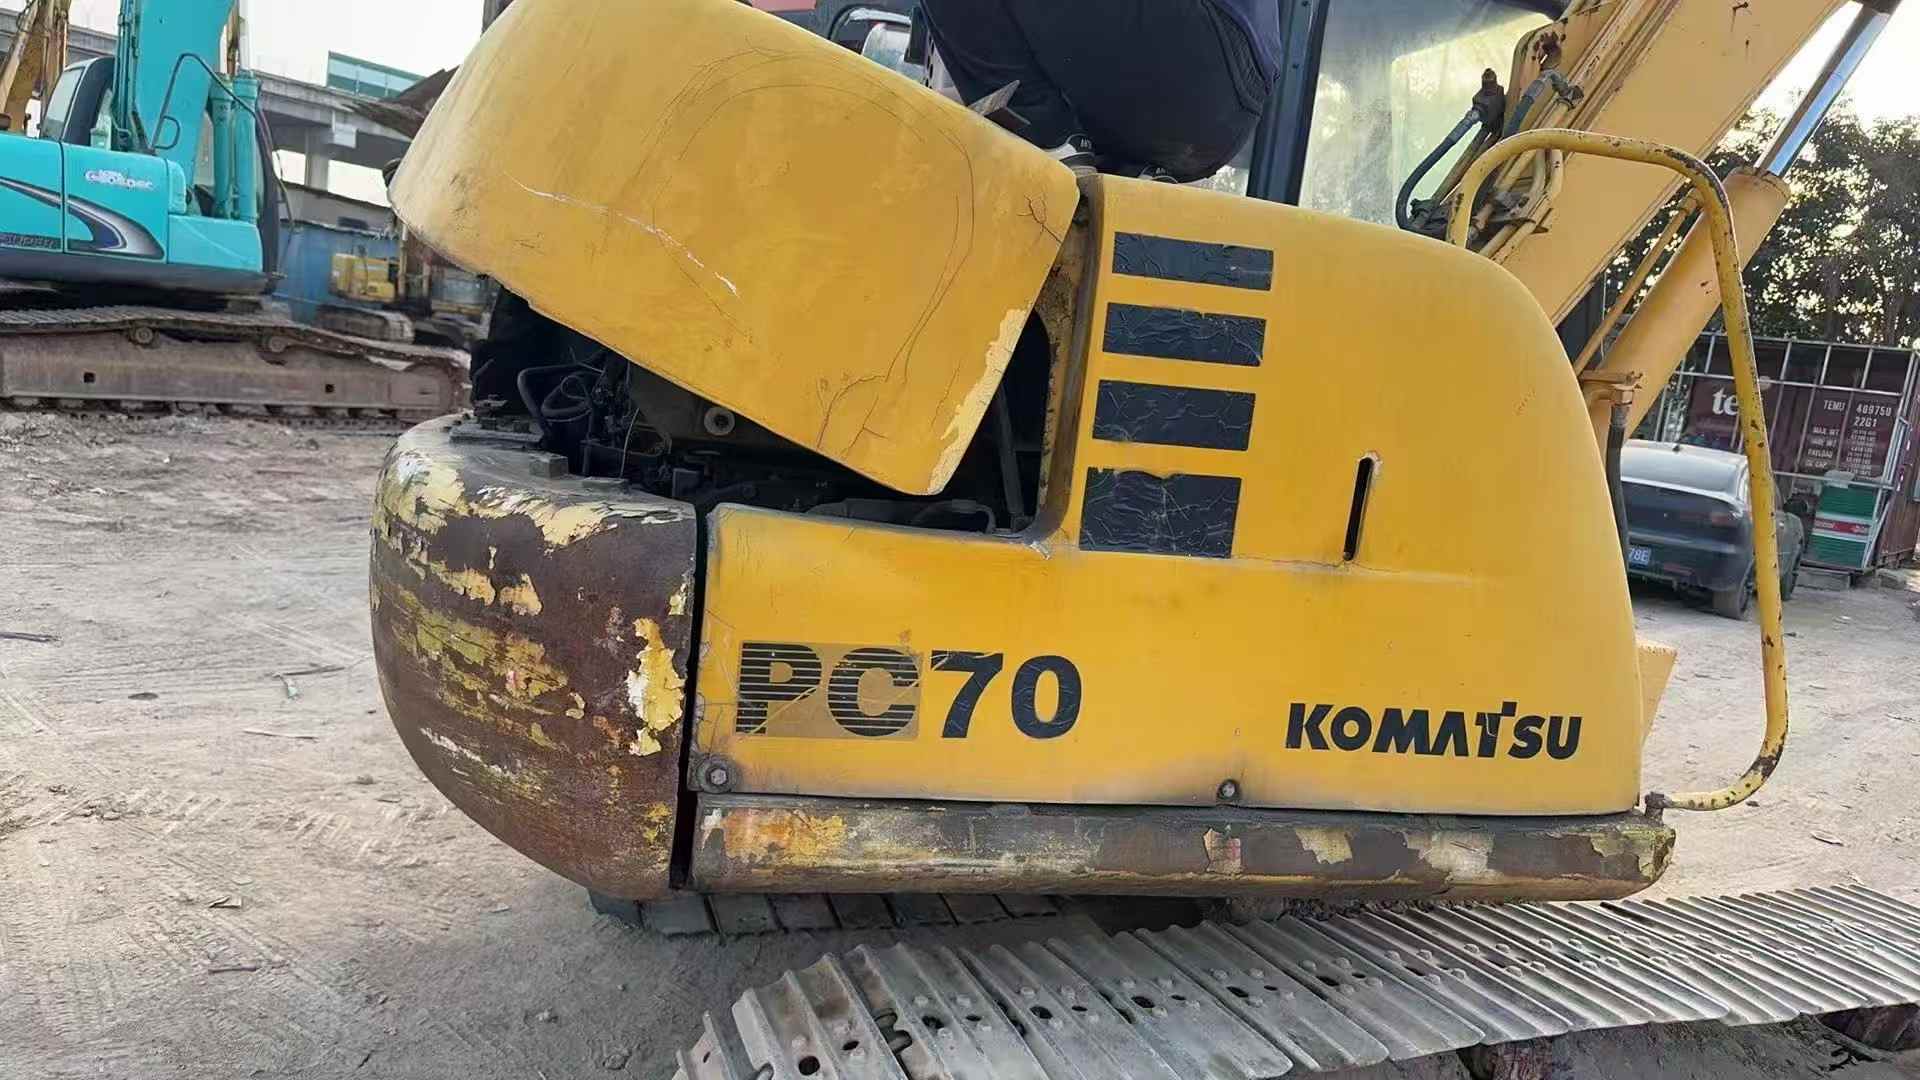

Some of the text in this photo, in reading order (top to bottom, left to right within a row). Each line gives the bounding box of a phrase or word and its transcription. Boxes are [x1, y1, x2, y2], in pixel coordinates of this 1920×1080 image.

[1712, 387, 1739, 416] te
[1823, 399, 1846, 411] TEMU
[1854, 417, 1878, 427] 22G1
[735, 642, 1083, 739] PC70
[1285, 701, 1582, 760] KOMATSU
